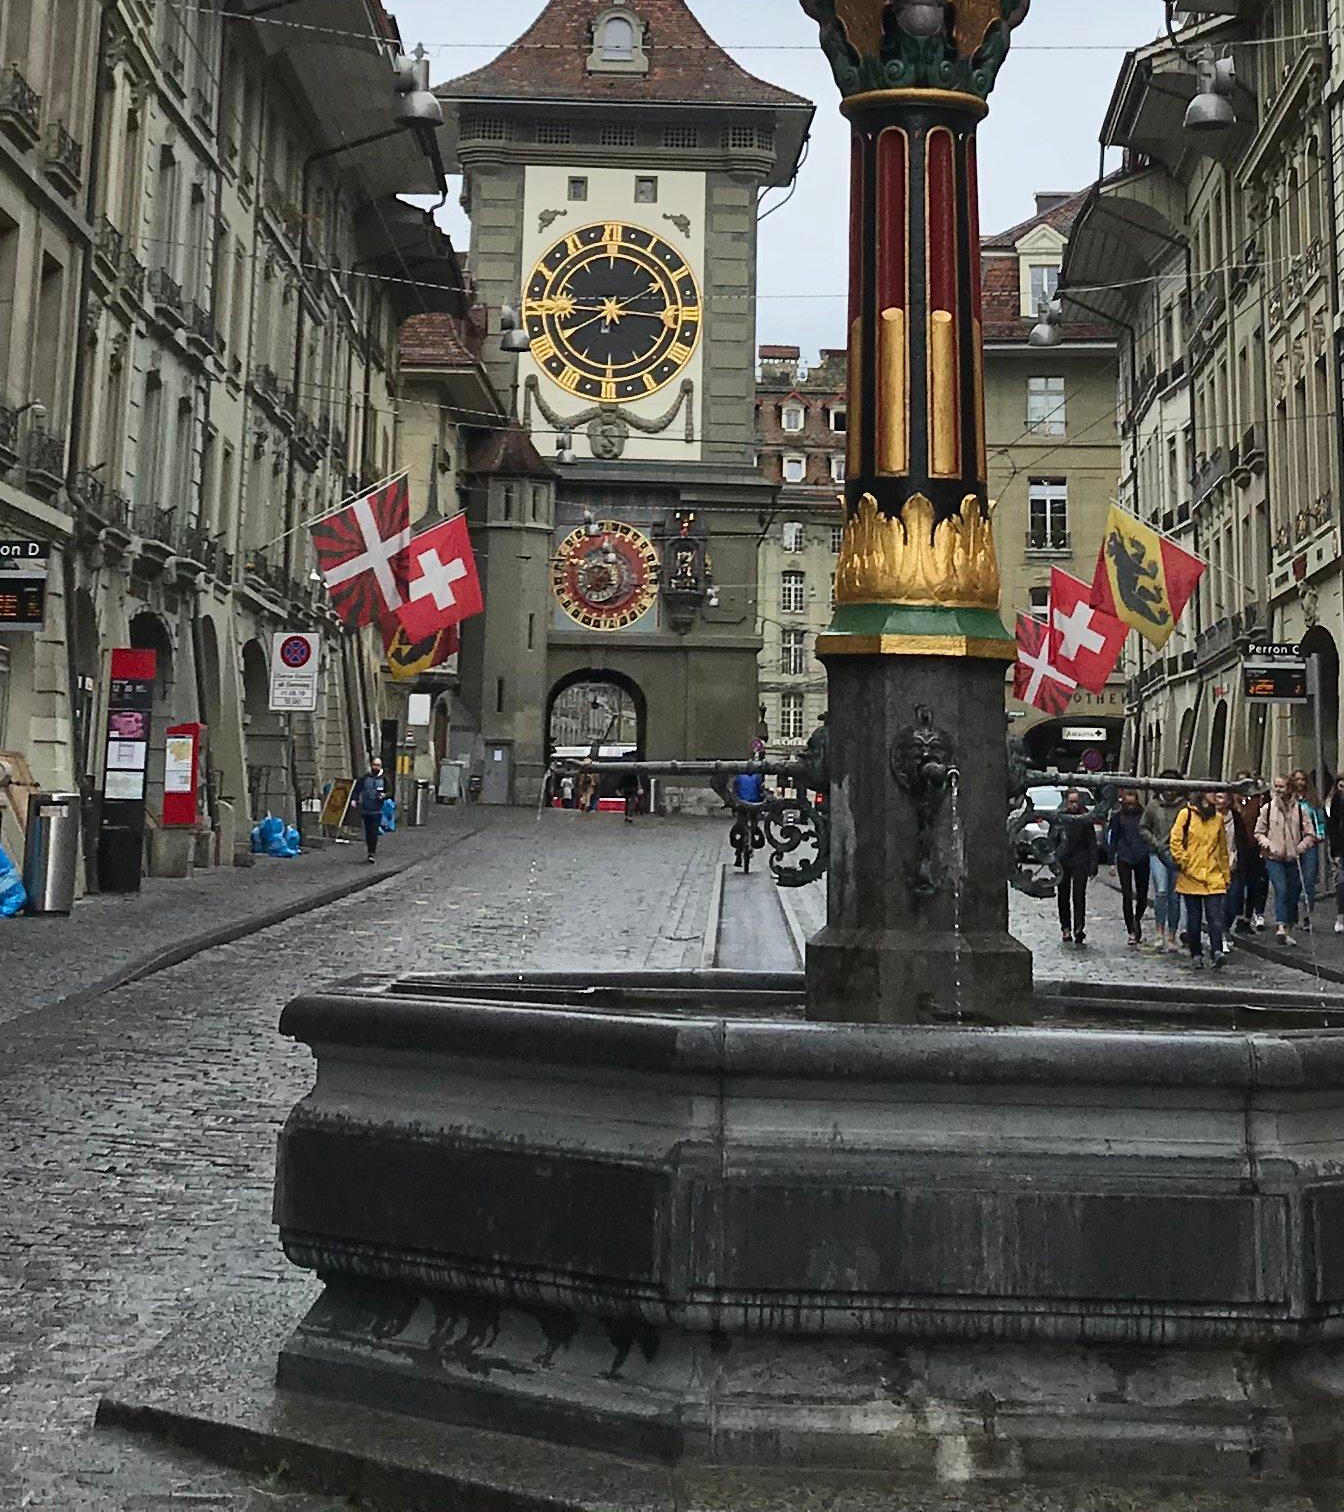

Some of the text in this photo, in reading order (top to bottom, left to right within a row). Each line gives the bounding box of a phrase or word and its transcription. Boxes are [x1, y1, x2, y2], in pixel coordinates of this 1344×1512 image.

[27, 542, 40, 556] D
[1248, 643, 1300, 655] Perron C
